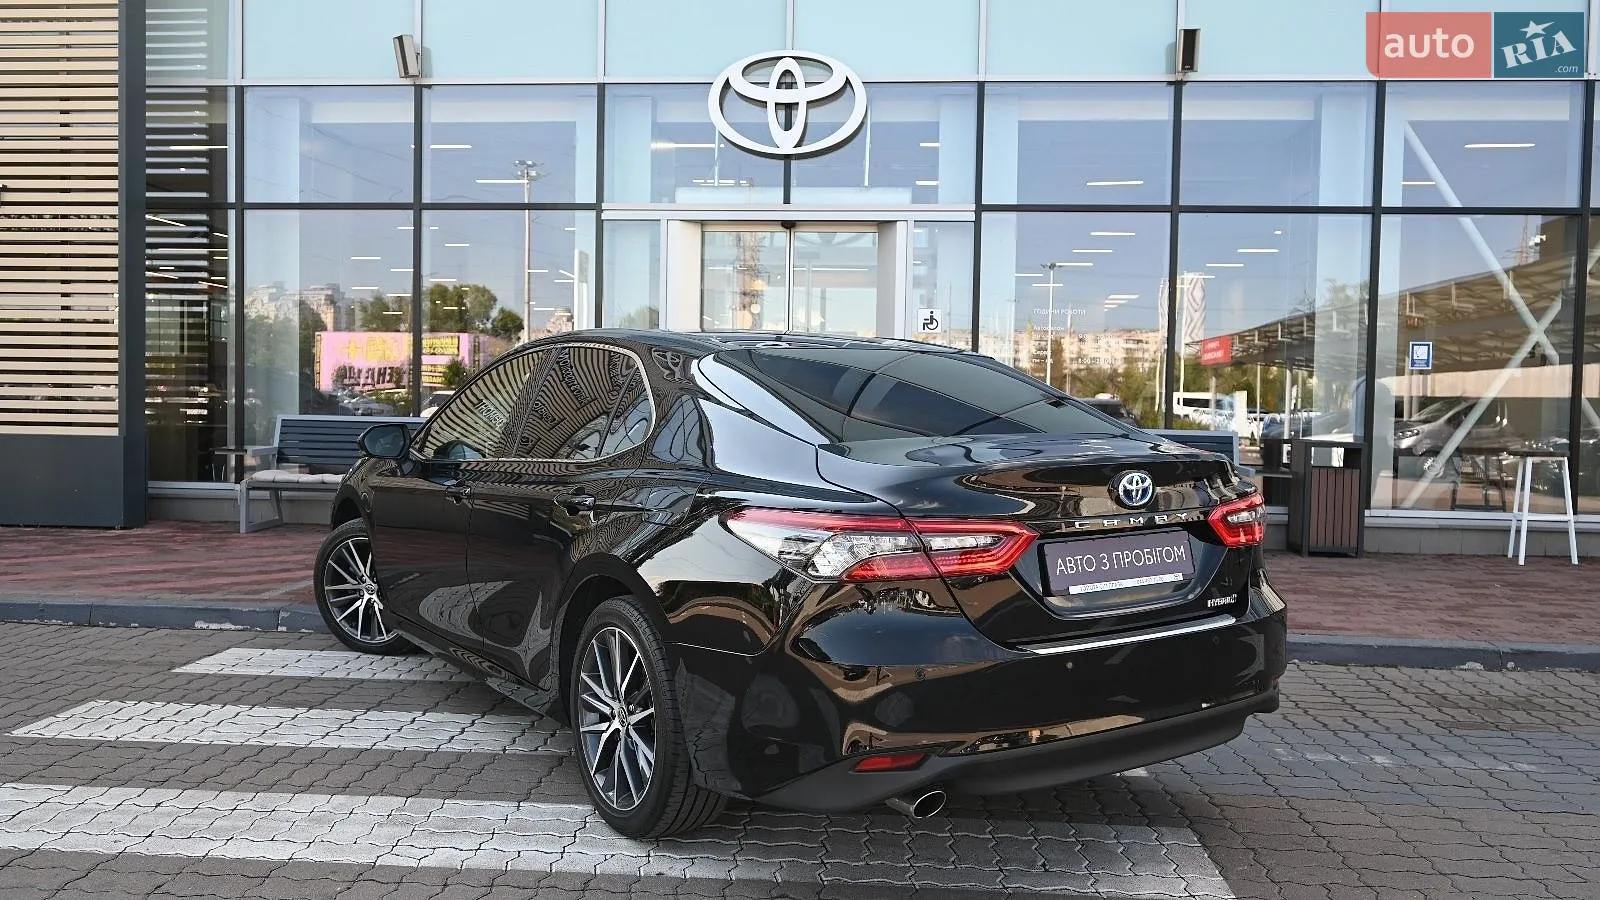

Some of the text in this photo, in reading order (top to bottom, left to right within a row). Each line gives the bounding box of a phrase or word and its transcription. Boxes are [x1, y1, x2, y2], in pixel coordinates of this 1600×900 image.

[1075, 512, 1188, 529] CAMRY
[1056, 545, 1186, 576] АВТО З ПРОБІГОМ
